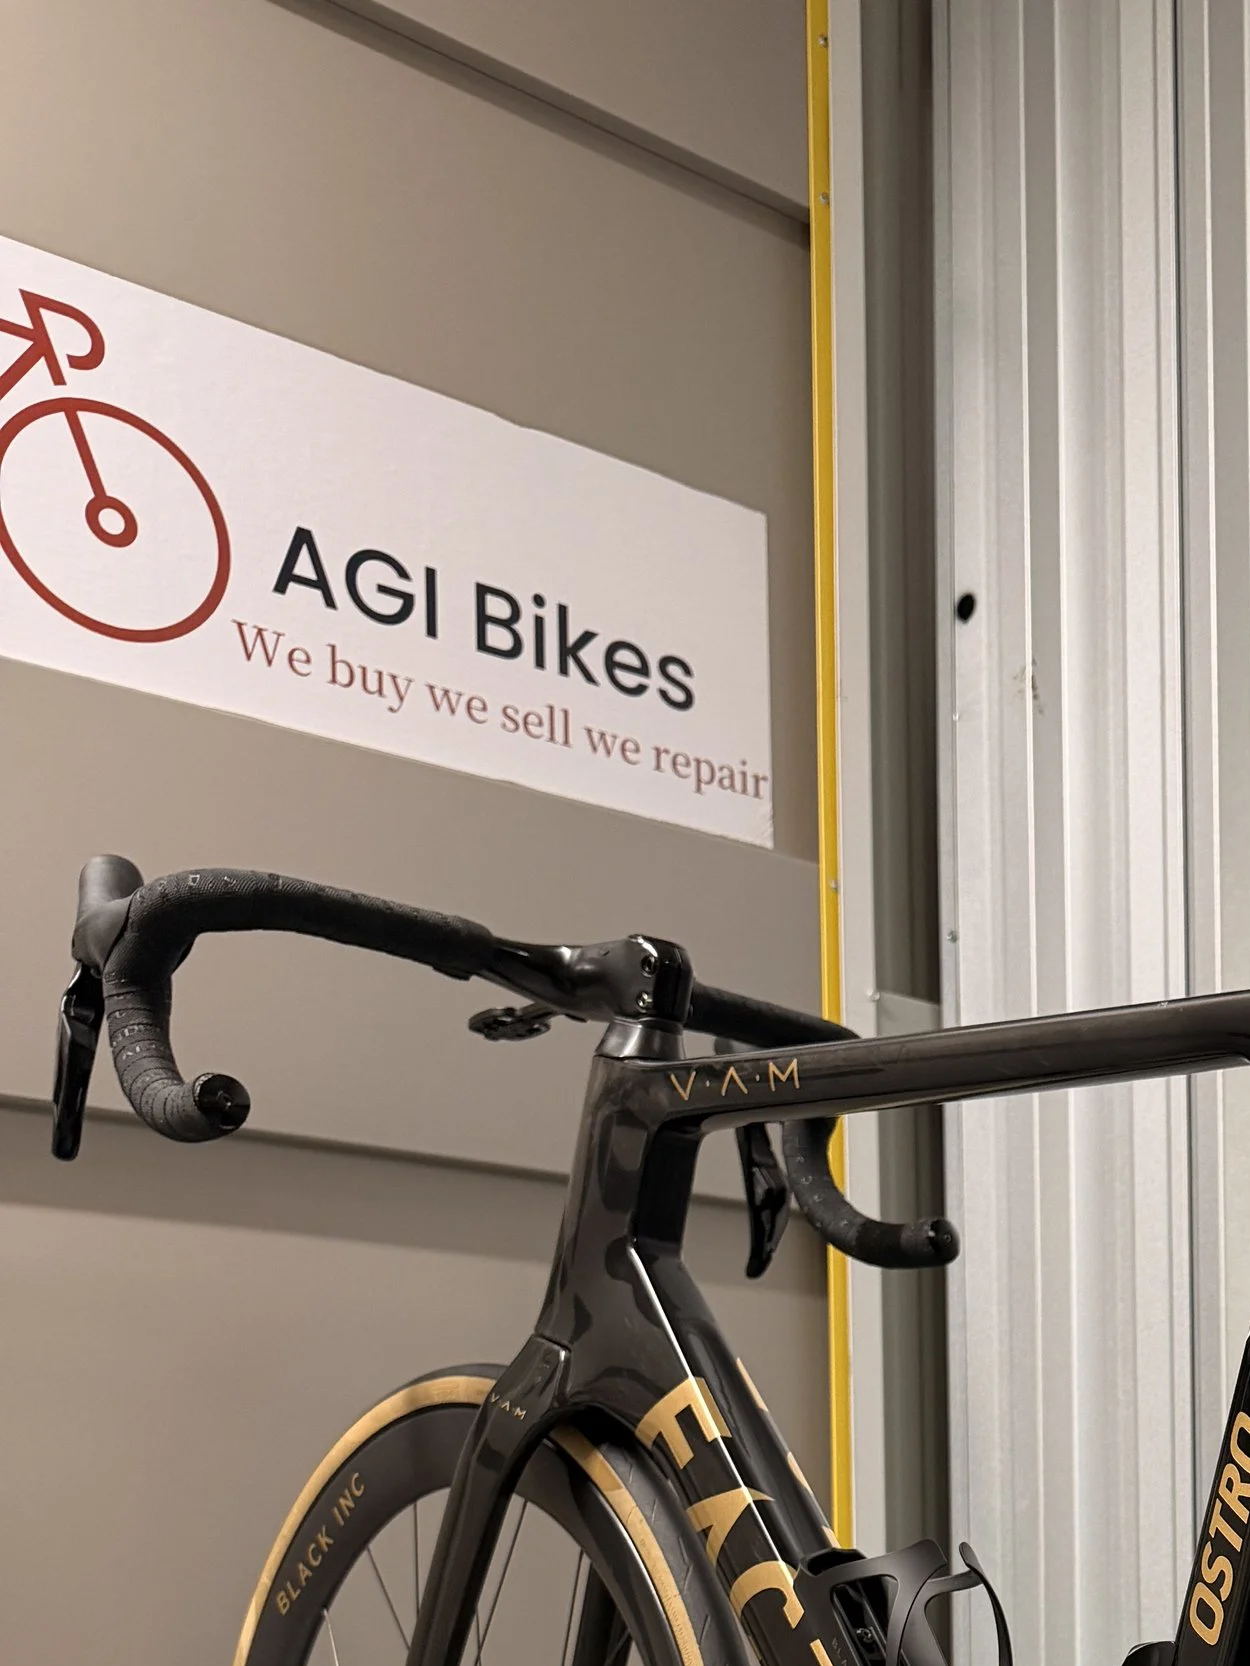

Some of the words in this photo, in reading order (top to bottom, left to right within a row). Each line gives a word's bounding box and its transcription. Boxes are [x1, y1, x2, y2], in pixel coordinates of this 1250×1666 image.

[231, 618, 312, 677] We
[326, 644, 414, 713] buy
[425, 682, 489, 725] we
[501, 704, 573, 748] sell
[584, 725, 641, 765] we
[652, 744, 769, 800] repair
[272, 526, 438, 640] AGI
[475, 581, 696, 712] Bikes
[275, 1525, 335, 1617] BLACK
[331, 1472, 365, 1526] INC
